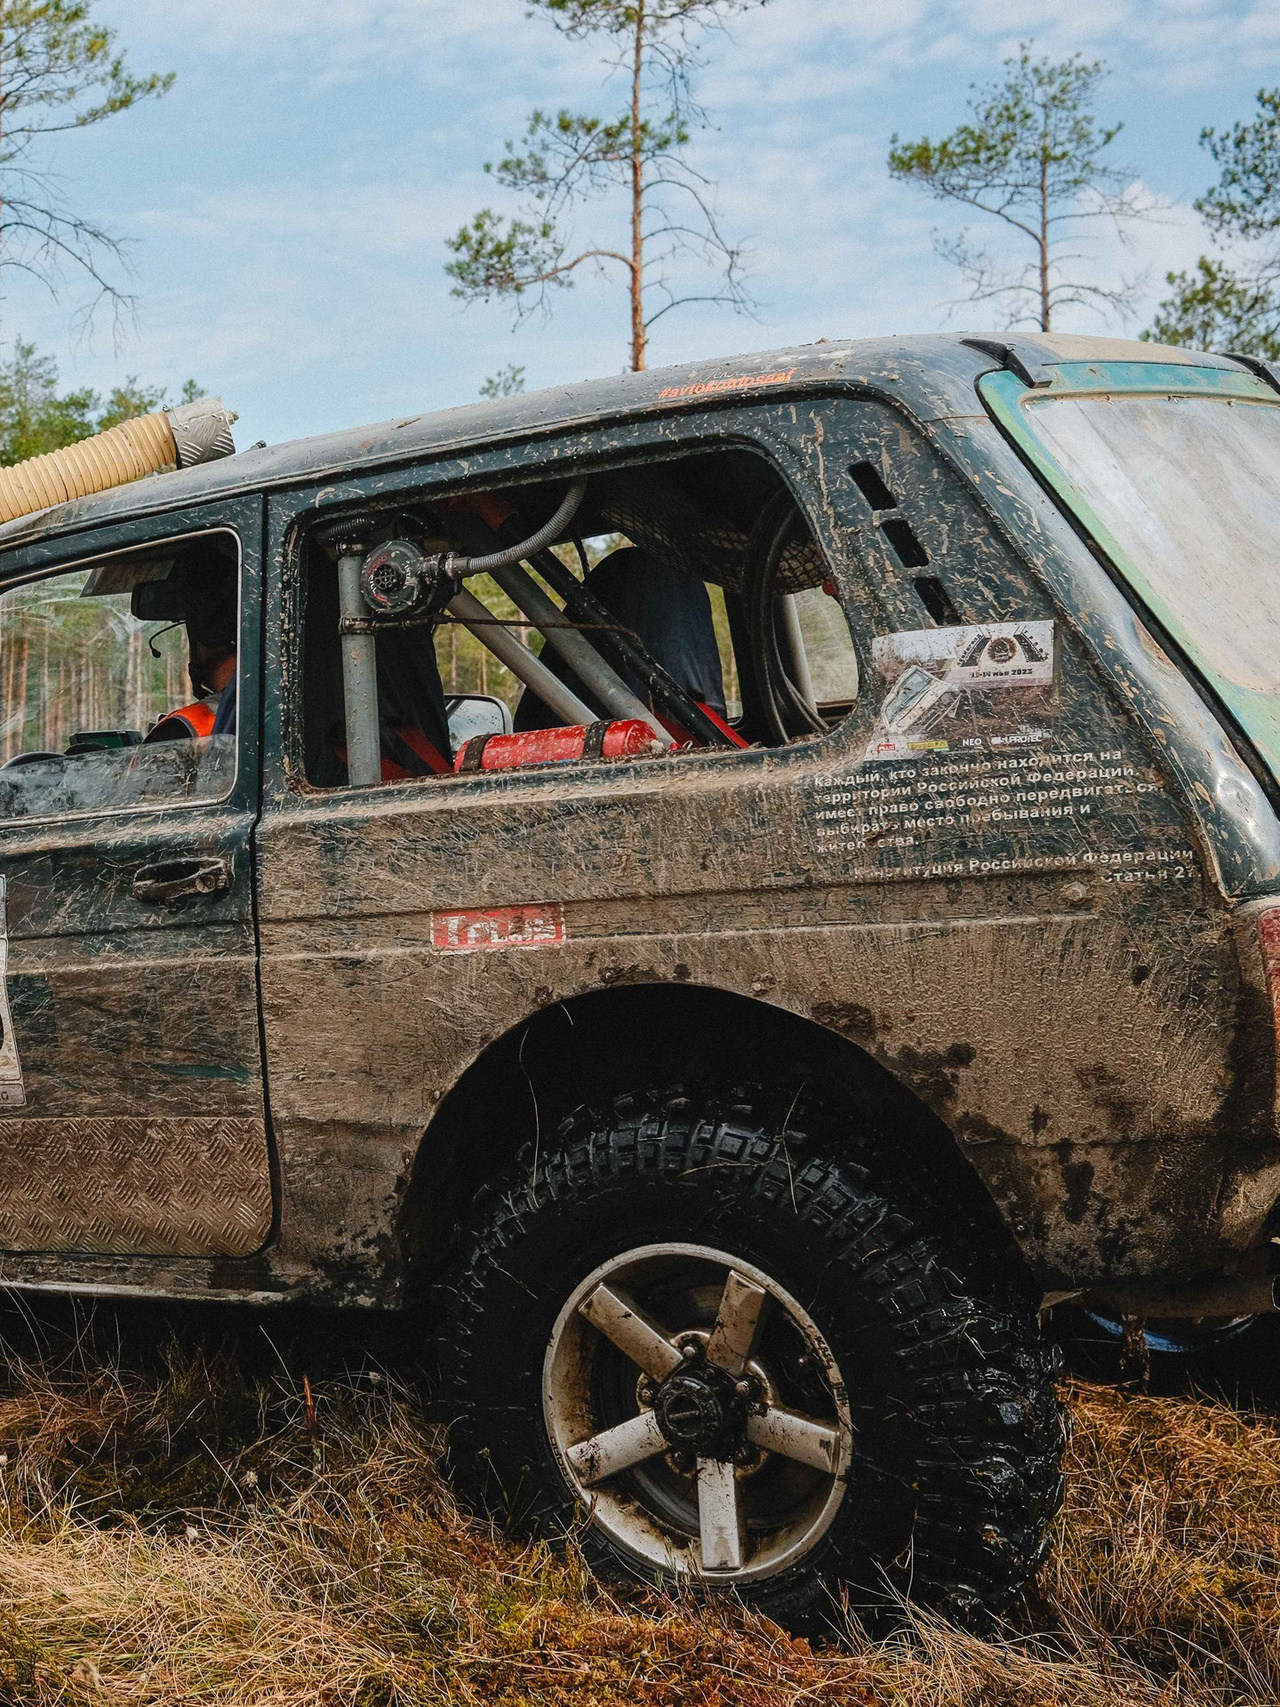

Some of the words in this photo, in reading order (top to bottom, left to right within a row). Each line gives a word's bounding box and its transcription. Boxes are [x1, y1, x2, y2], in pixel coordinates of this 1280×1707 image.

[962, 738, 982, 747] NEO
[815, 770, 884, 788] Каждый,
[890, 769, 916, 780] кто
[922, 761, 991, 777] законно
[997, 752, 1093, 770] находится
[1100, 750, 1121, 761] на
[814, 787, 911, 805] территории
[917, 774, 1020, 794] Российской
[868, 801, 919, 817] право
[924, 793, 1010, 811] свободно
[904, 815, 954, 830] место
[1080, 804, 1090, 814] и
[817, 835, 919, 853] жителства.
